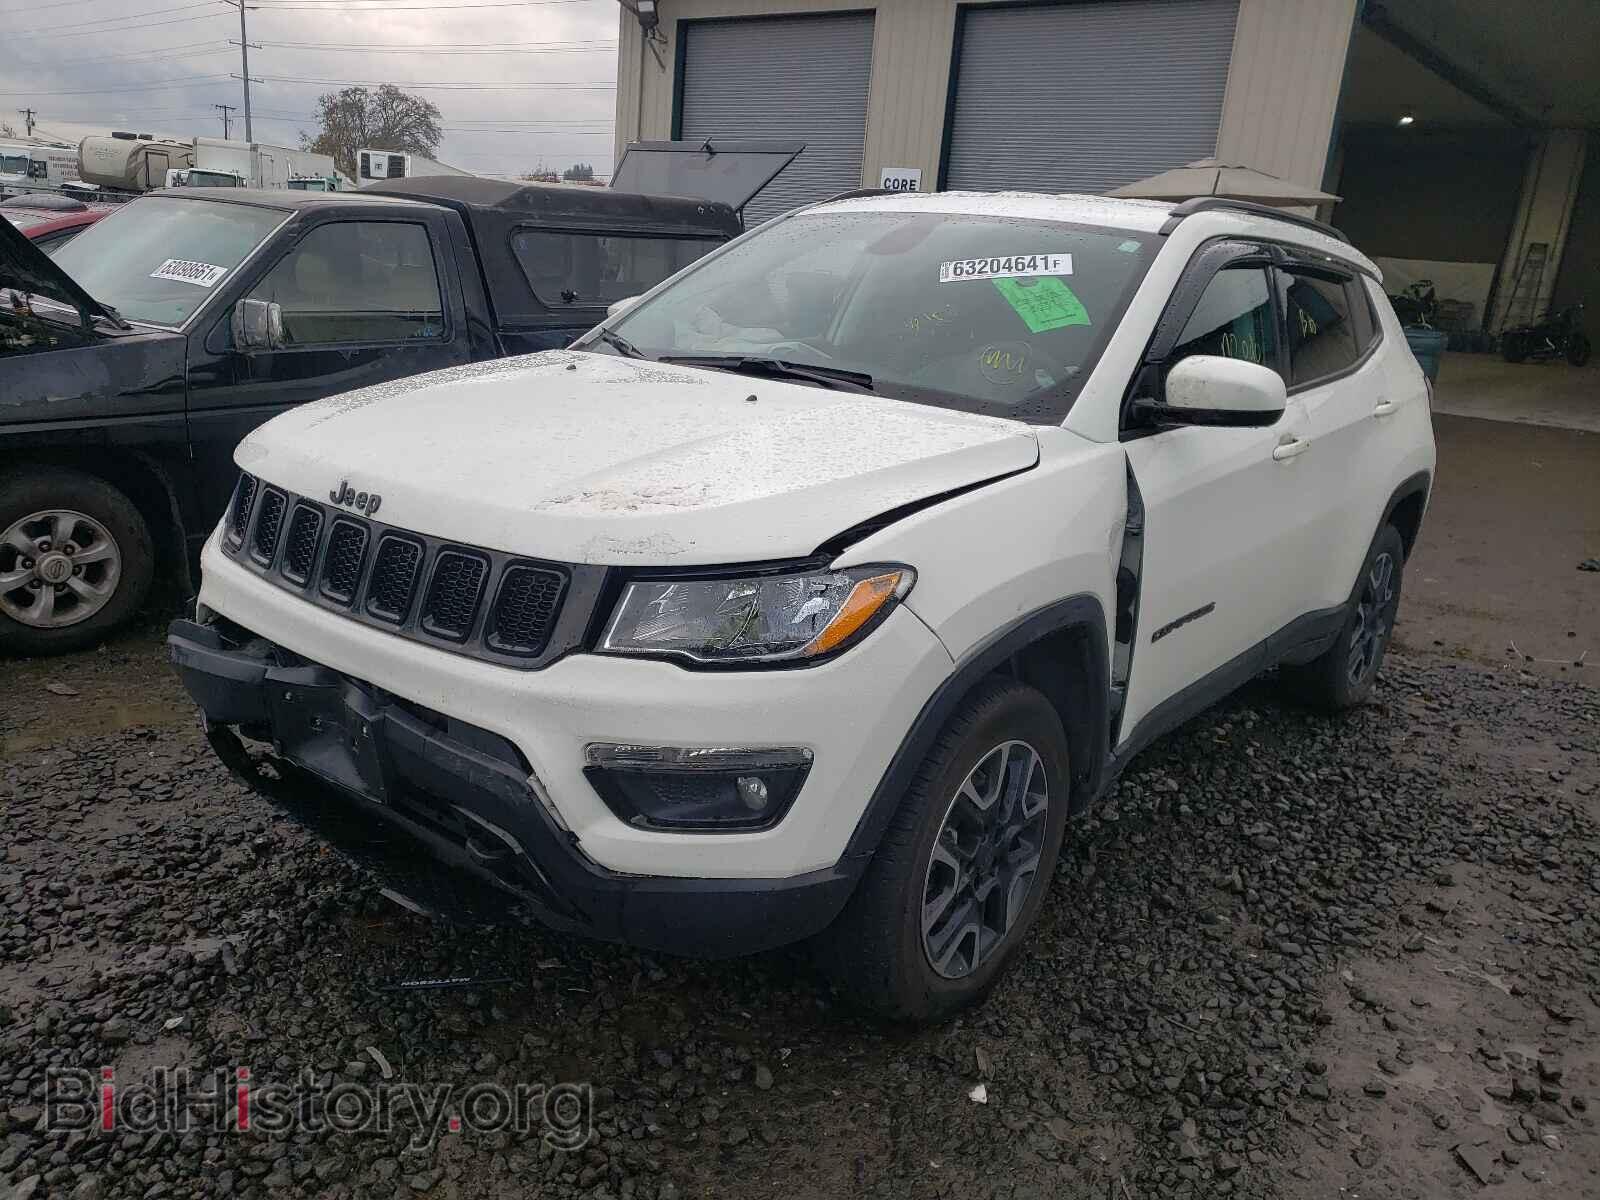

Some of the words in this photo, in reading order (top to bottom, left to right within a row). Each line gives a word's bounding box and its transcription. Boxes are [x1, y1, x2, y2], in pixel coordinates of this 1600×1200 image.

[883, 177, 917, 191] CORE
[953, 255, 1049, 277] 63204641
[329, 481, 382, 517] Jeep
